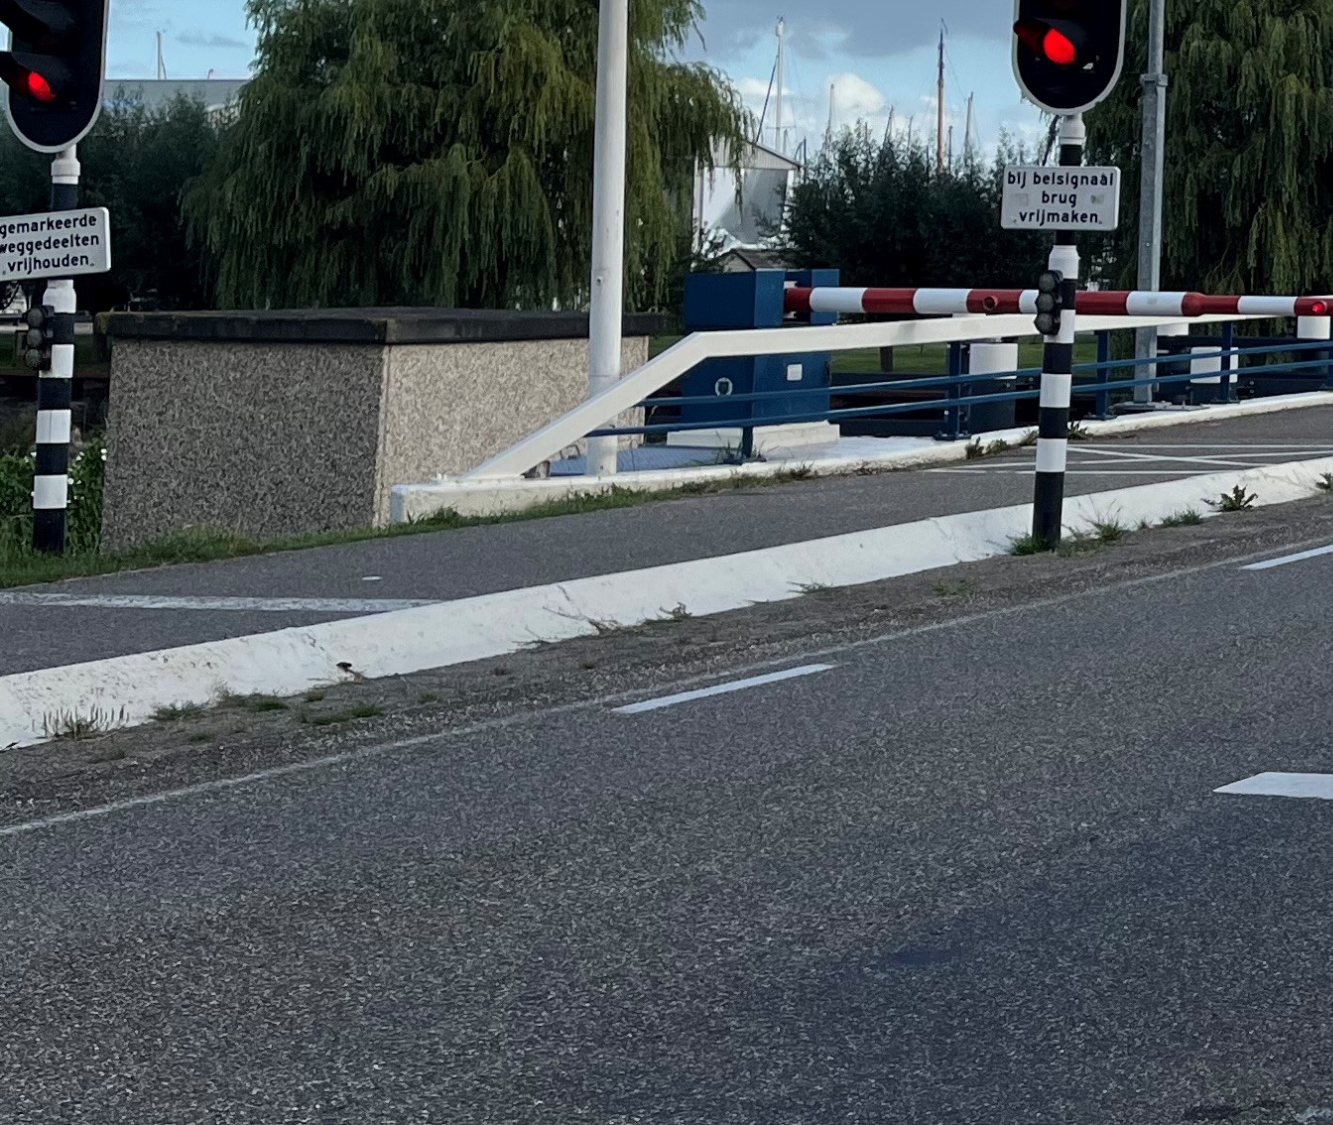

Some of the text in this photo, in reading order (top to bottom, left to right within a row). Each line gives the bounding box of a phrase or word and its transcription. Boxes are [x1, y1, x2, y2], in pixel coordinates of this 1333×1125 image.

[1007, 171, 1113, 189] bij belsignaal
[1041, 191, 1077, 208] brug
